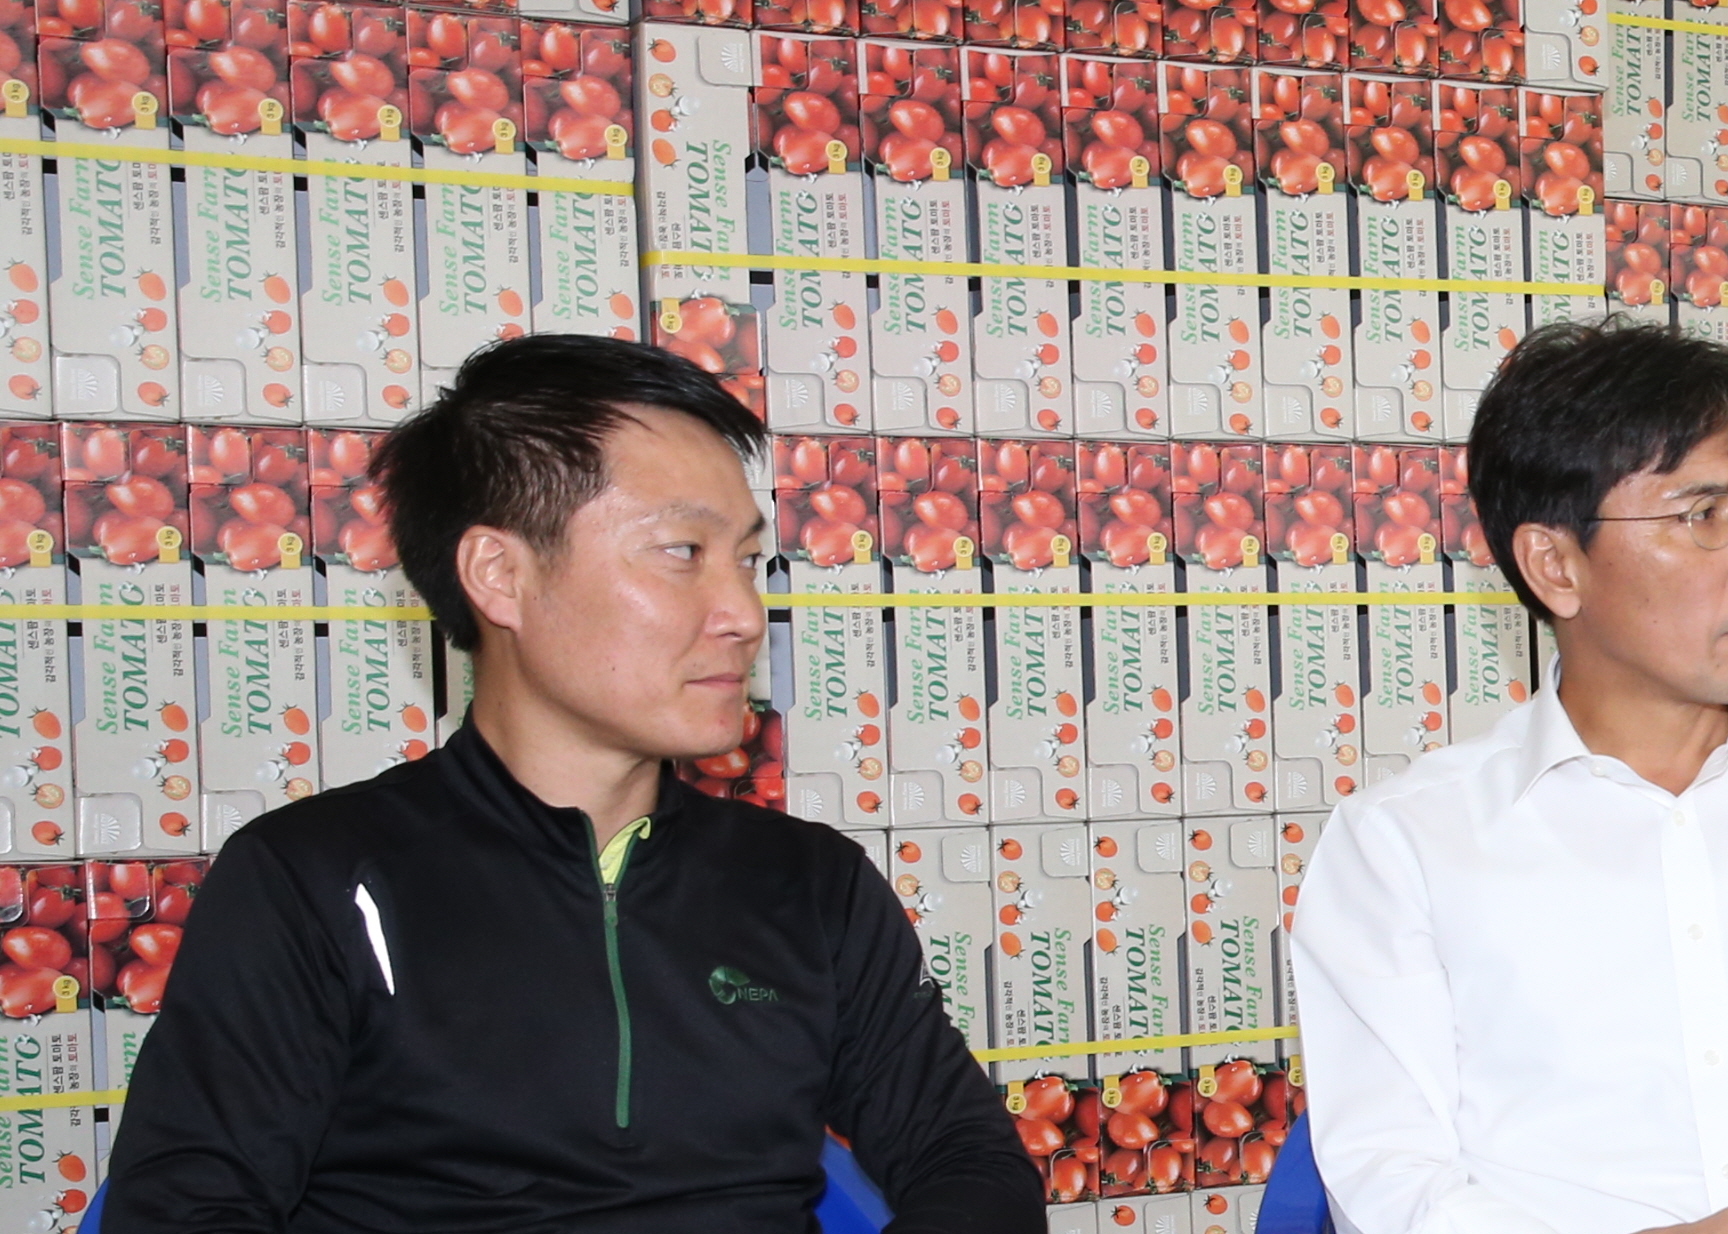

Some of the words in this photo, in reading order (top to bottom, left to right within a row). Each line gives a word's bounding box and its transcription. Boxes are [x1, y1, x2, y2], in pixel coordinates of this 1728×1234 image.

[1613, 66, 1623, 116] Sense
[1683, 72, 1693, 122] Sense
[133, 182, 144, 210] 센스팜
[258, 187, 269, 214] 센스팜
[713, 140, 731, 207] Sense
[378, 192, 388, 219] 센스팜
[776, 191, 793, 255] Farm
[825, 193, 834, 218] 토마토
[838, 195, 847, 219] 토마토
[882, 198, 898, 259] Farm
[930, 201, 938, 224] 토마토
[942, 202, 950, 225] 토마토
[984, 203, 1000, 263] Farm
[1031, 205, 1039, 229] 토마토
[1043, 206, 1051, 229] 토마토
[1129, 207, 1137, 231] 토마토
[1223, 215, 1231, 239] 토마토
[1315, 212, 1323, 236] 토마토
[1326, 213, 1334, 236] 토마토
[73, 226, 93, 299] Sense
[827, 222, 837, 248] 센스팜
[930, 228, 940, 254] 센스팜
[1032, 233, 1041, 258] 센스팜
[1084, 205, 1099, 267] Farm
[1130, 235, 1139, 259] 센스팜
[1179, 213, 1194, 271] Farm
[1224, 243, 1233, 266] 센스팜
[1272, 210, 1287, 269] Farm
[1316, 239, 1325, 263] 센스팜
[1364, 216, 1378, 274] Farm
[1407, 243, 1416, 269] 센스팜
[1452, 226, 1466, 279] Farm
[201, 231, 221, 302] Sense
[323, 241, 342, 305] Sense
[440, 246, 458, 315] Sense
[554, 251, 571, 319] Sense
[1494, 254, 1502, 277] 센스팜
[96, 662, 118, 734] Sense
[221, 667, 242, 737] Sense
[342, 665, 361, 735] Sense
[805, 655, 822, 721] Sense
[907, 659, 924, 724] Sense
[1006, 656, 1023, 720] Sense
[1103, 652, 1119, 715] Sense
[1198, 654, 1214, 715] Sense
[1290, 649, 1304, 710] Sense
[1378, 648, 1392, 708] Sense
[1466, 647, 1479, 705] Sense
[955, 932, 972, 996] Sense
[1054, 928, 1071, 991] Sense
[1149, 924, 1165, 986] Sense
[1243, 916, 1259, 977] Sense
[737, 987, 779, 1001] NEPA
[52, 1034, 62, 1063] 토마토
[67, 1035, 78, 1061] 토마토
